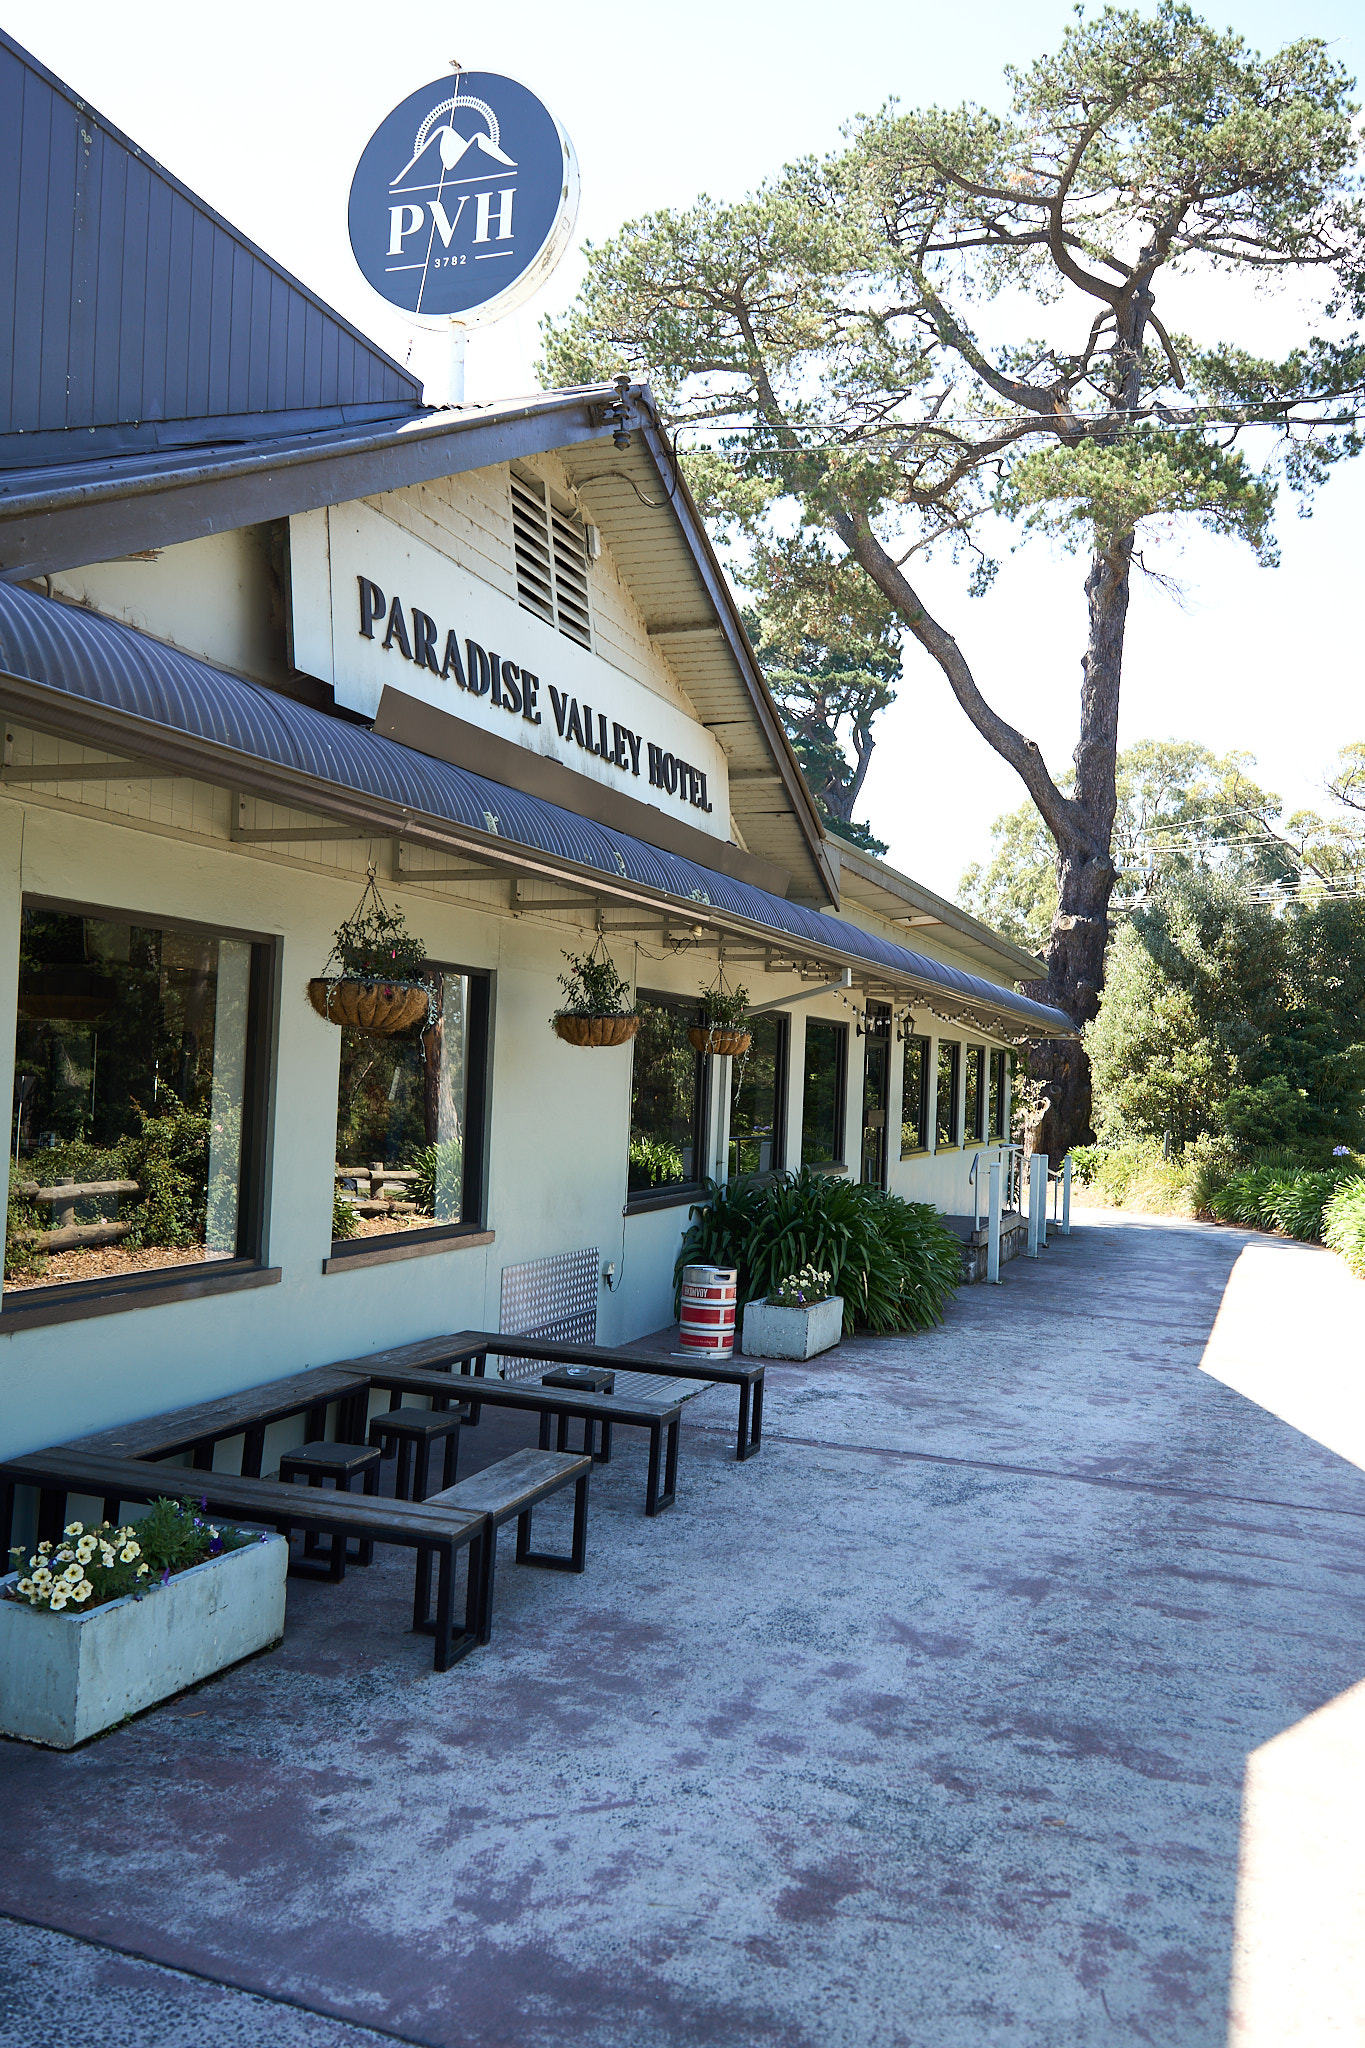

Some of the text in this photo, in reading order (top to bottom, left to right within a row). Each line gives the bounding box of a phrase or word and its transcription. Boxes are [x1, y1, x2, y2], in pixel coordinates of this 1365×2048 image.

[386, 188, 517, 256] PVH
[434, 255, 467, 268] 3782
[358, 575, 712, 813] PARADISE VALLEY HOTEL
